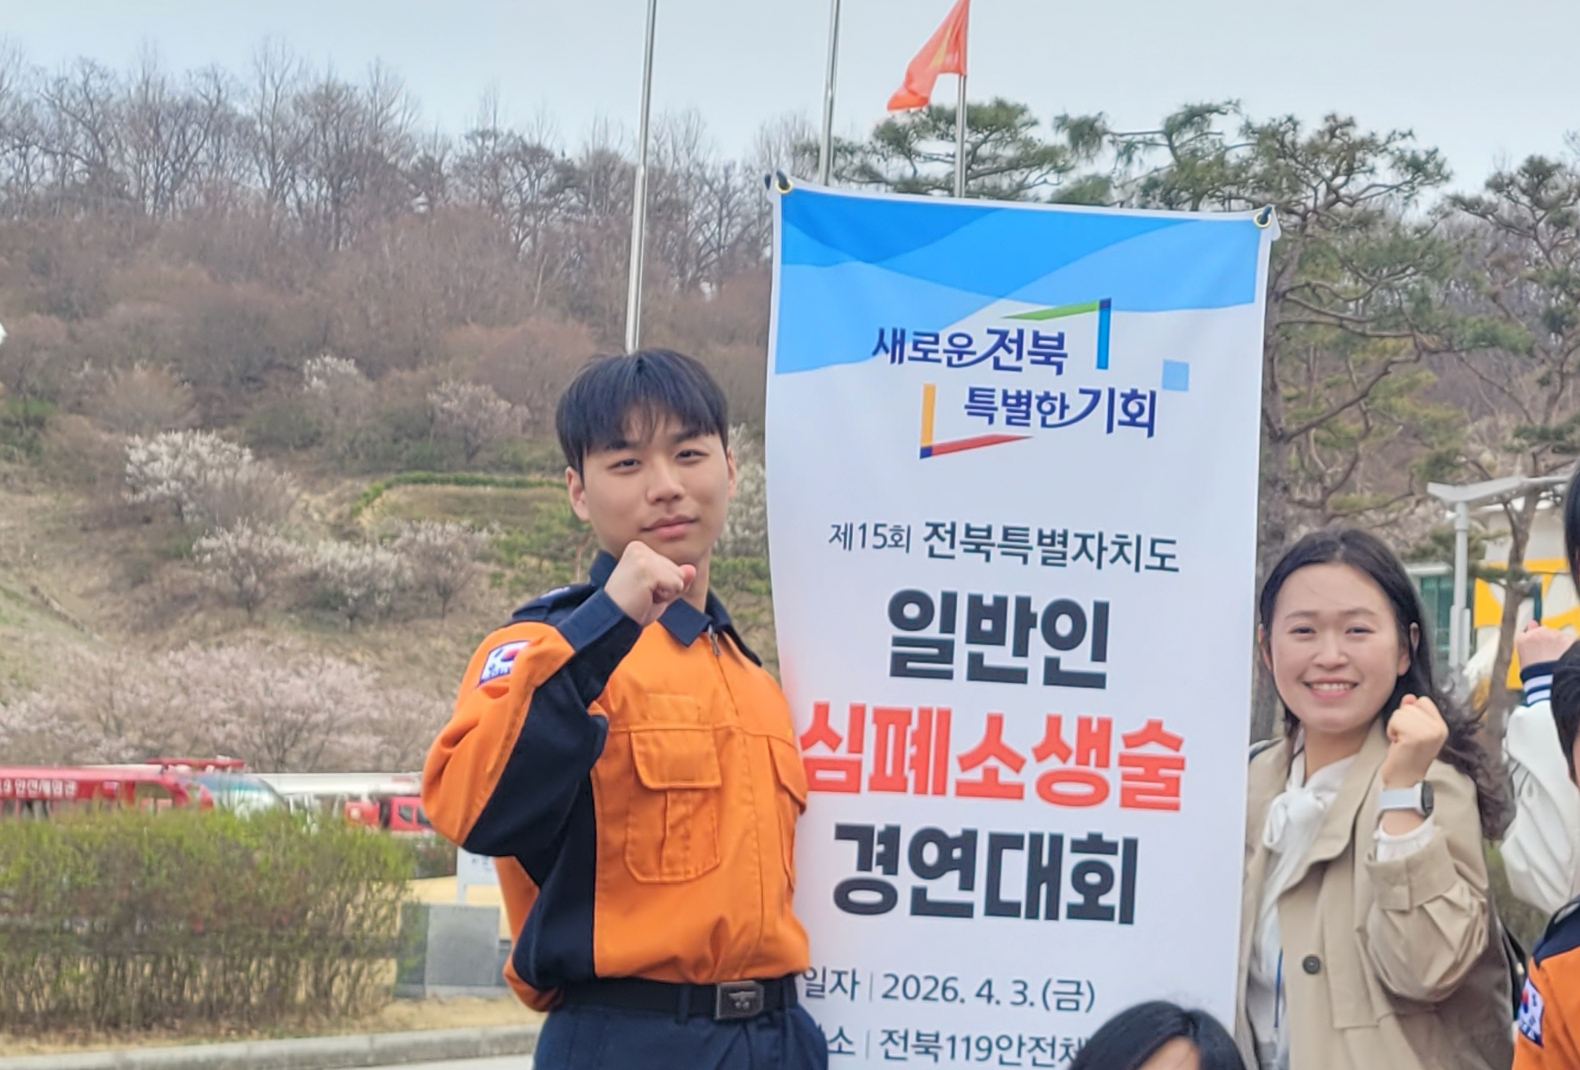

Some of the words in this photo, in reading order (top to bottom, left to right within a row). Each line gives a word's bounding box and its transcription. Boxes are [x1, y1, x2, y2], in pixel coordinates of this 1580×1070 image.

[828, 522, 912, 554] 제15회
[922, 520, 1181, 573] 전북특별자치도
[887, 588, 1110, 690] 일반인
[800, 701, 1187, 812] 심폐소생술
[832, 822, 1139, 925] 경연대회
[802, 966, 860, 1001] 일자
[881, 973, 966, 1004] 2026.
[974, 978, 1001, 1006] 4.
[817, 1024, 856, 1056] 소
